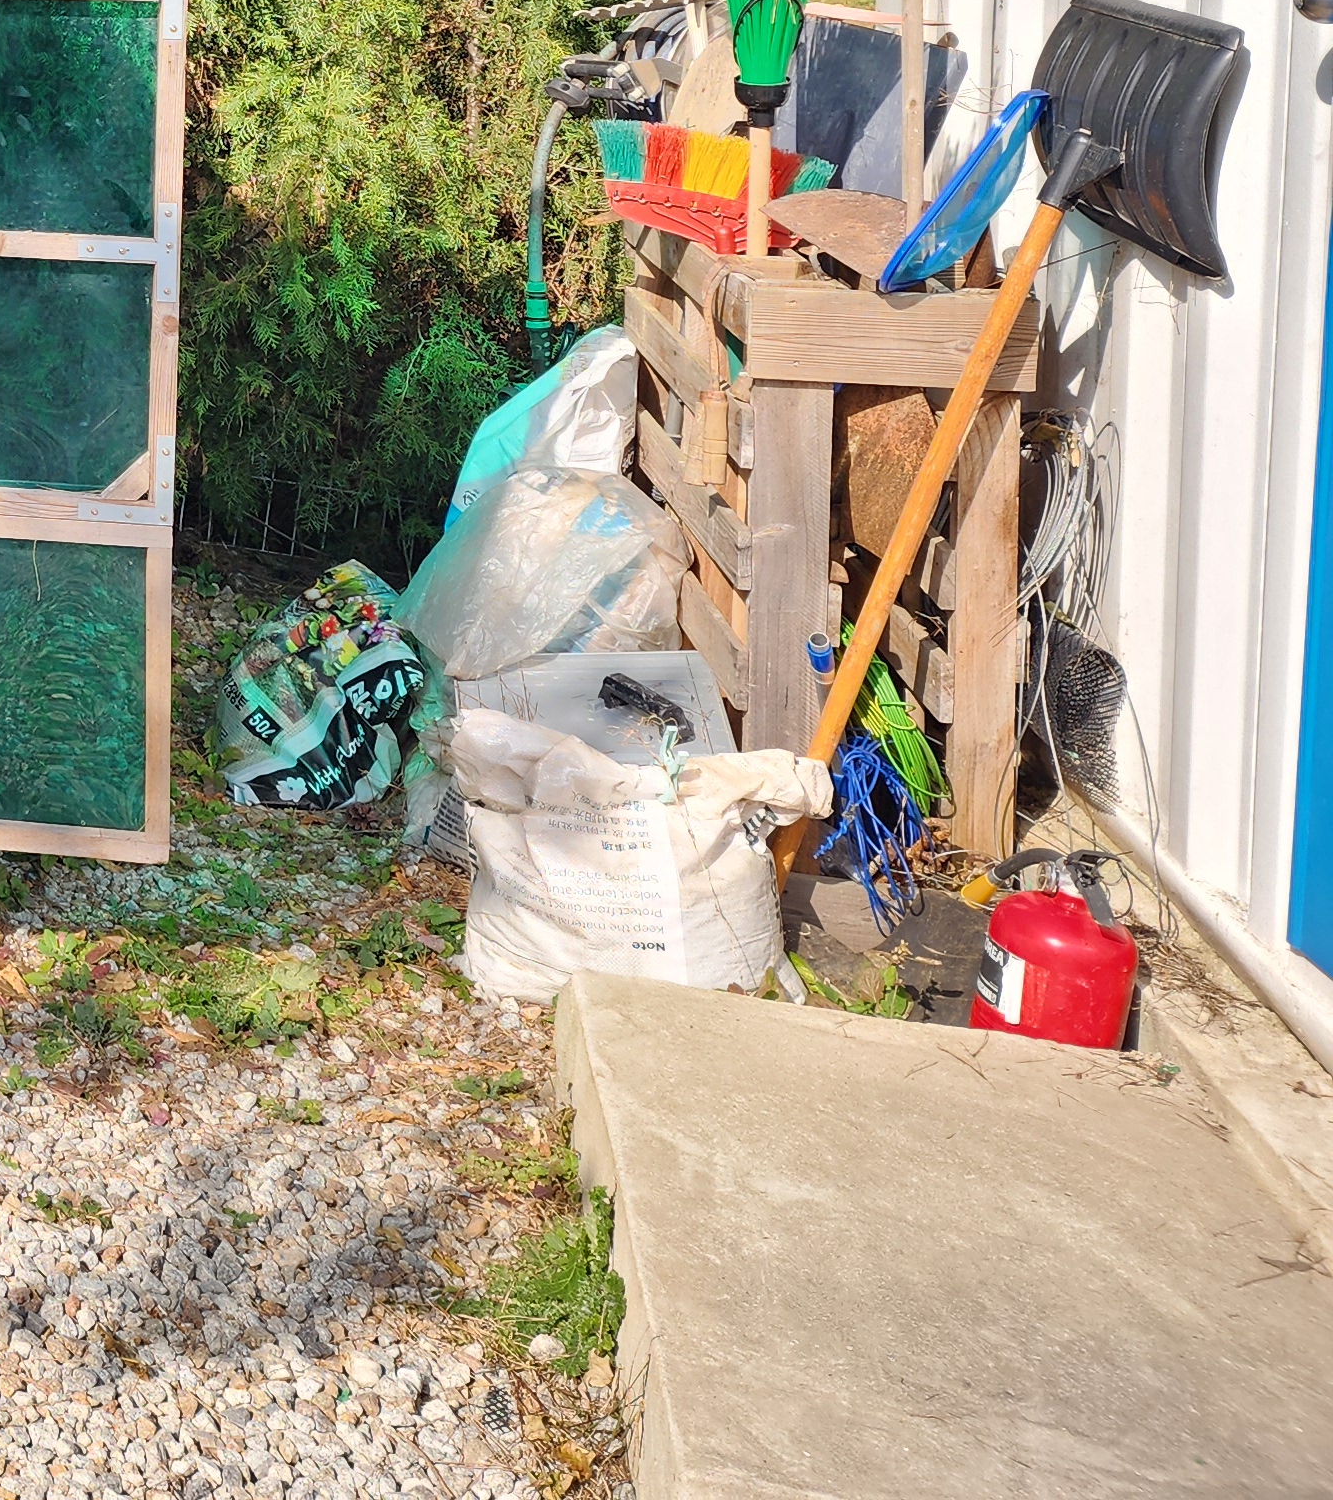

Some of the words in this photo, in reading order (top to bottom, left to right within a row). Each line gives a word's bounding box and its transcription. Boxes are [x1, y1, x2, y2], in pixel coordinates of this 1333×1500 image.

[307, 766, 342, 796] With
[619, 889, 661, 901] violent
[548, 898, 582, 913] direct
[585, 905, 615, 917] from
[618, 908, 663, 918] Protect
[558, 916, 606, 930] material
[610, 924, 630, 933] the
[632, 942, 666, 952] Note
